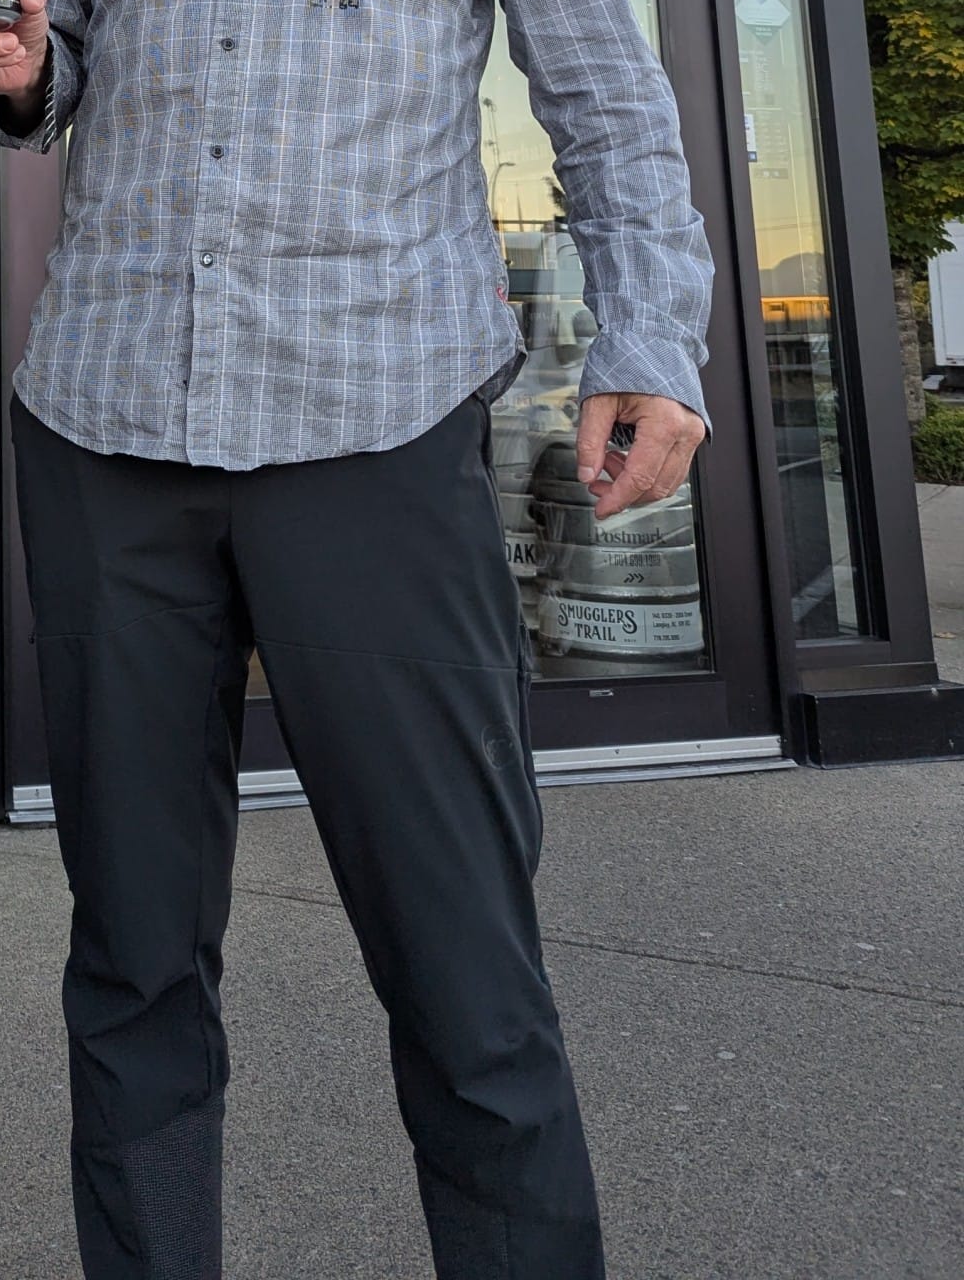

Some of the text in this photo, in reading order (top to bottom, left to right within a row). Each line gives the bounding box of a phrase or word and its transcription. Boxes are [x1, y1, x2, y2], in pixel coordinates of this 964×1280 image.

[594, 526, 667, 545] Postmark
[558, 603, 637, 634] SMUGGLERS
[575, 623, 616, 641] TRAIL
